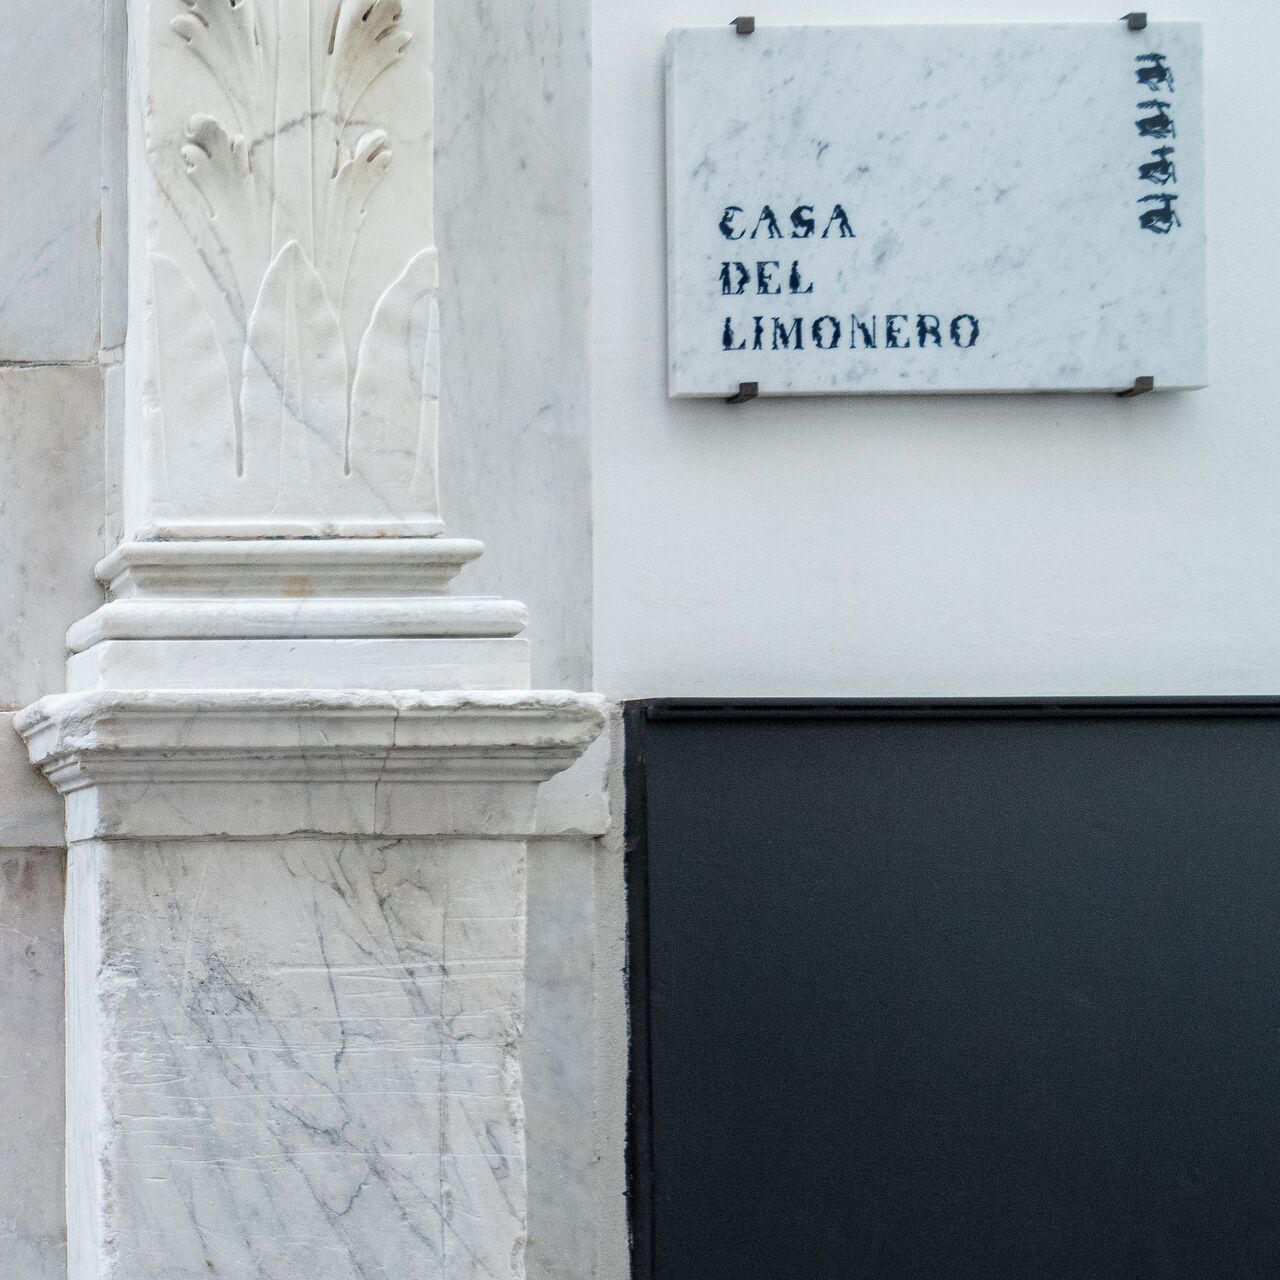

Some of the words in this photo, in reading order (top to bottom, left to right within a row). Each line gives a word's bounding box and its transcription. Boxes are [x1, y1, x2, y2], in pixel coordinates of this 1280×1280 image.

[718, 204, 856, 240] CASA
[718, 259, 814, 296] DEL
[722, 313, 980, 352] LIMONERO
